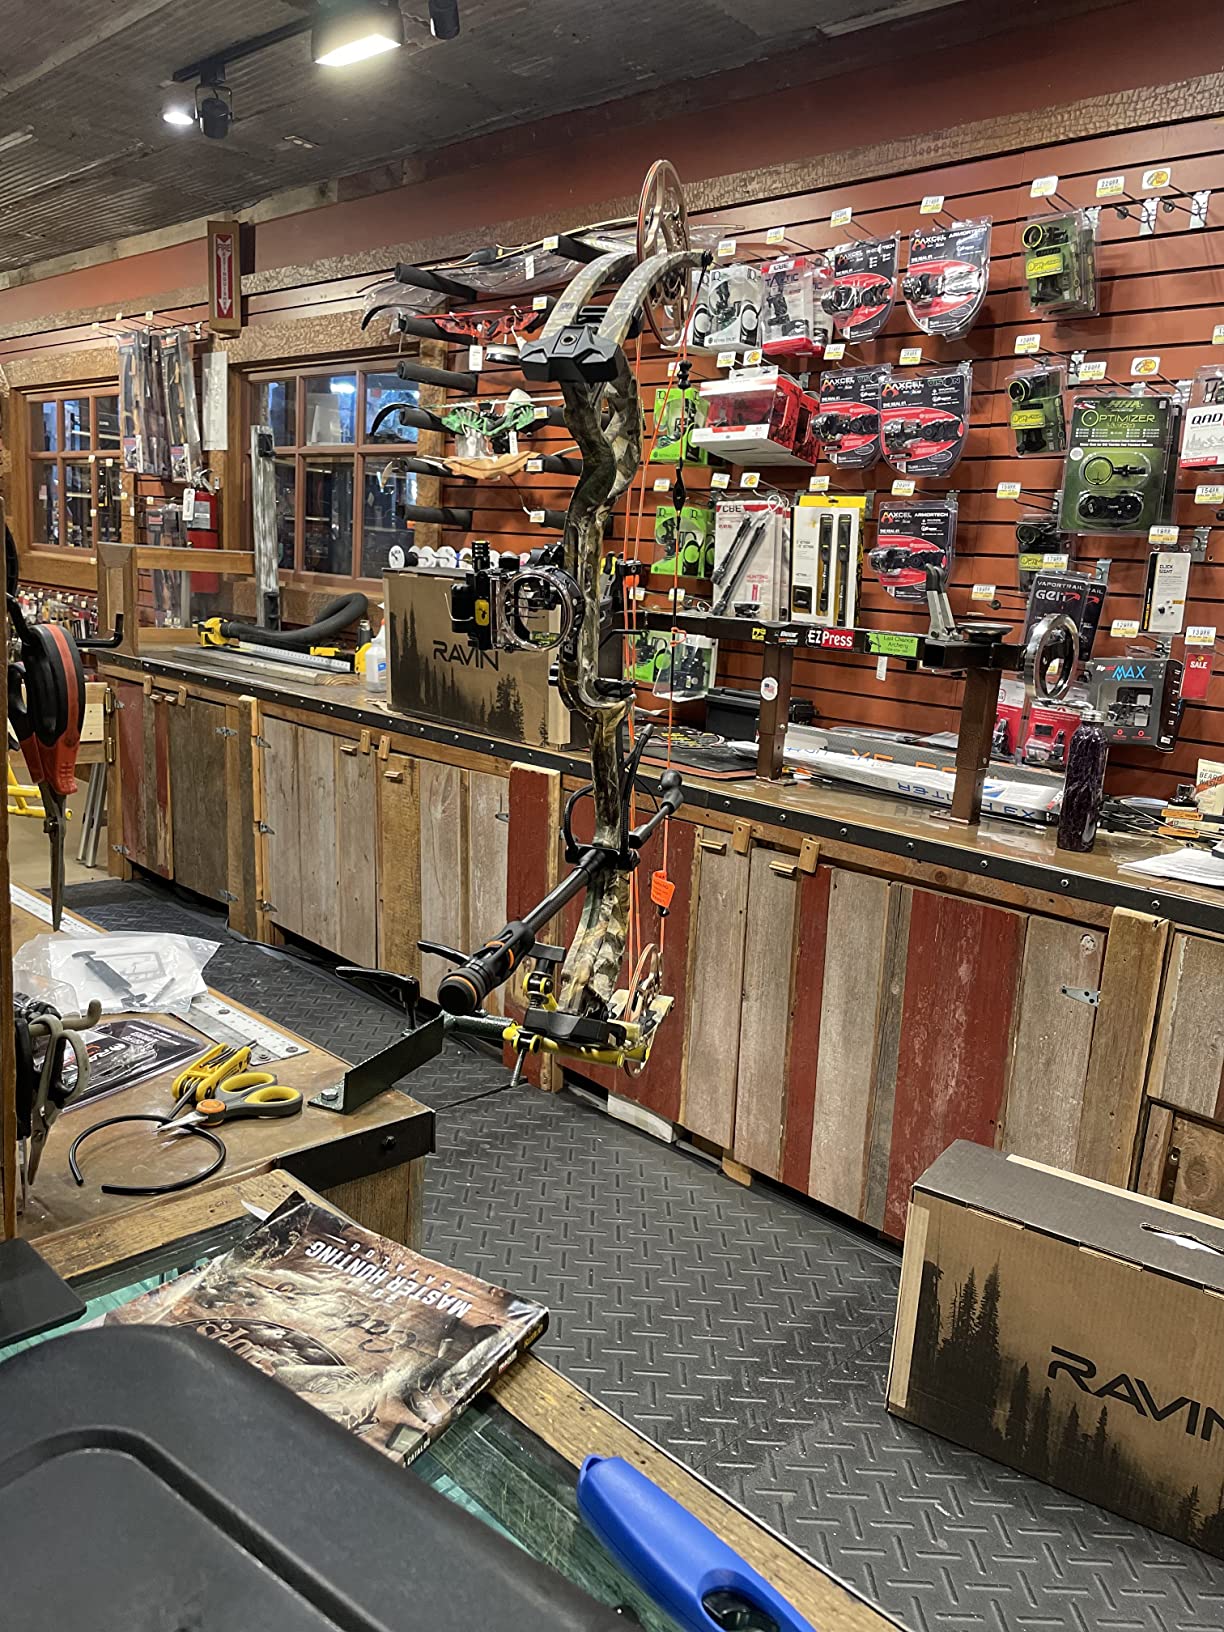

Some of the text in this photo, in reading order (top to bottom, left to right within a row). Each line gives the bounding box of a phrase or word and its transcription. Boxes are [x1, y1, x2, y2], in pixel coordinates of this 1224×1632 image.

[763, 273, 799, 288] TATIC
[1081, 410, 1155, 427] OPTIMIZER
[1191, 413, 1223, 425] QAD
[722, 505, 742, 513] CBE
[1036, 581, 1085, 591] VAPORTRAIL
[432, 640, 499, 672] RAVIN
[1189, 661, 1208, 669] SALE
[1112, 665, 1147, 681] MAX
[1199, 771, 1223, 782] BEARD
[1199, 779, 1218, 788] WASH
[303, 1240, 390, 1286] HUNTING
[349, 1241, 452, 1291] CATALOG
[386, 1275, 473, 1319] MASTER
